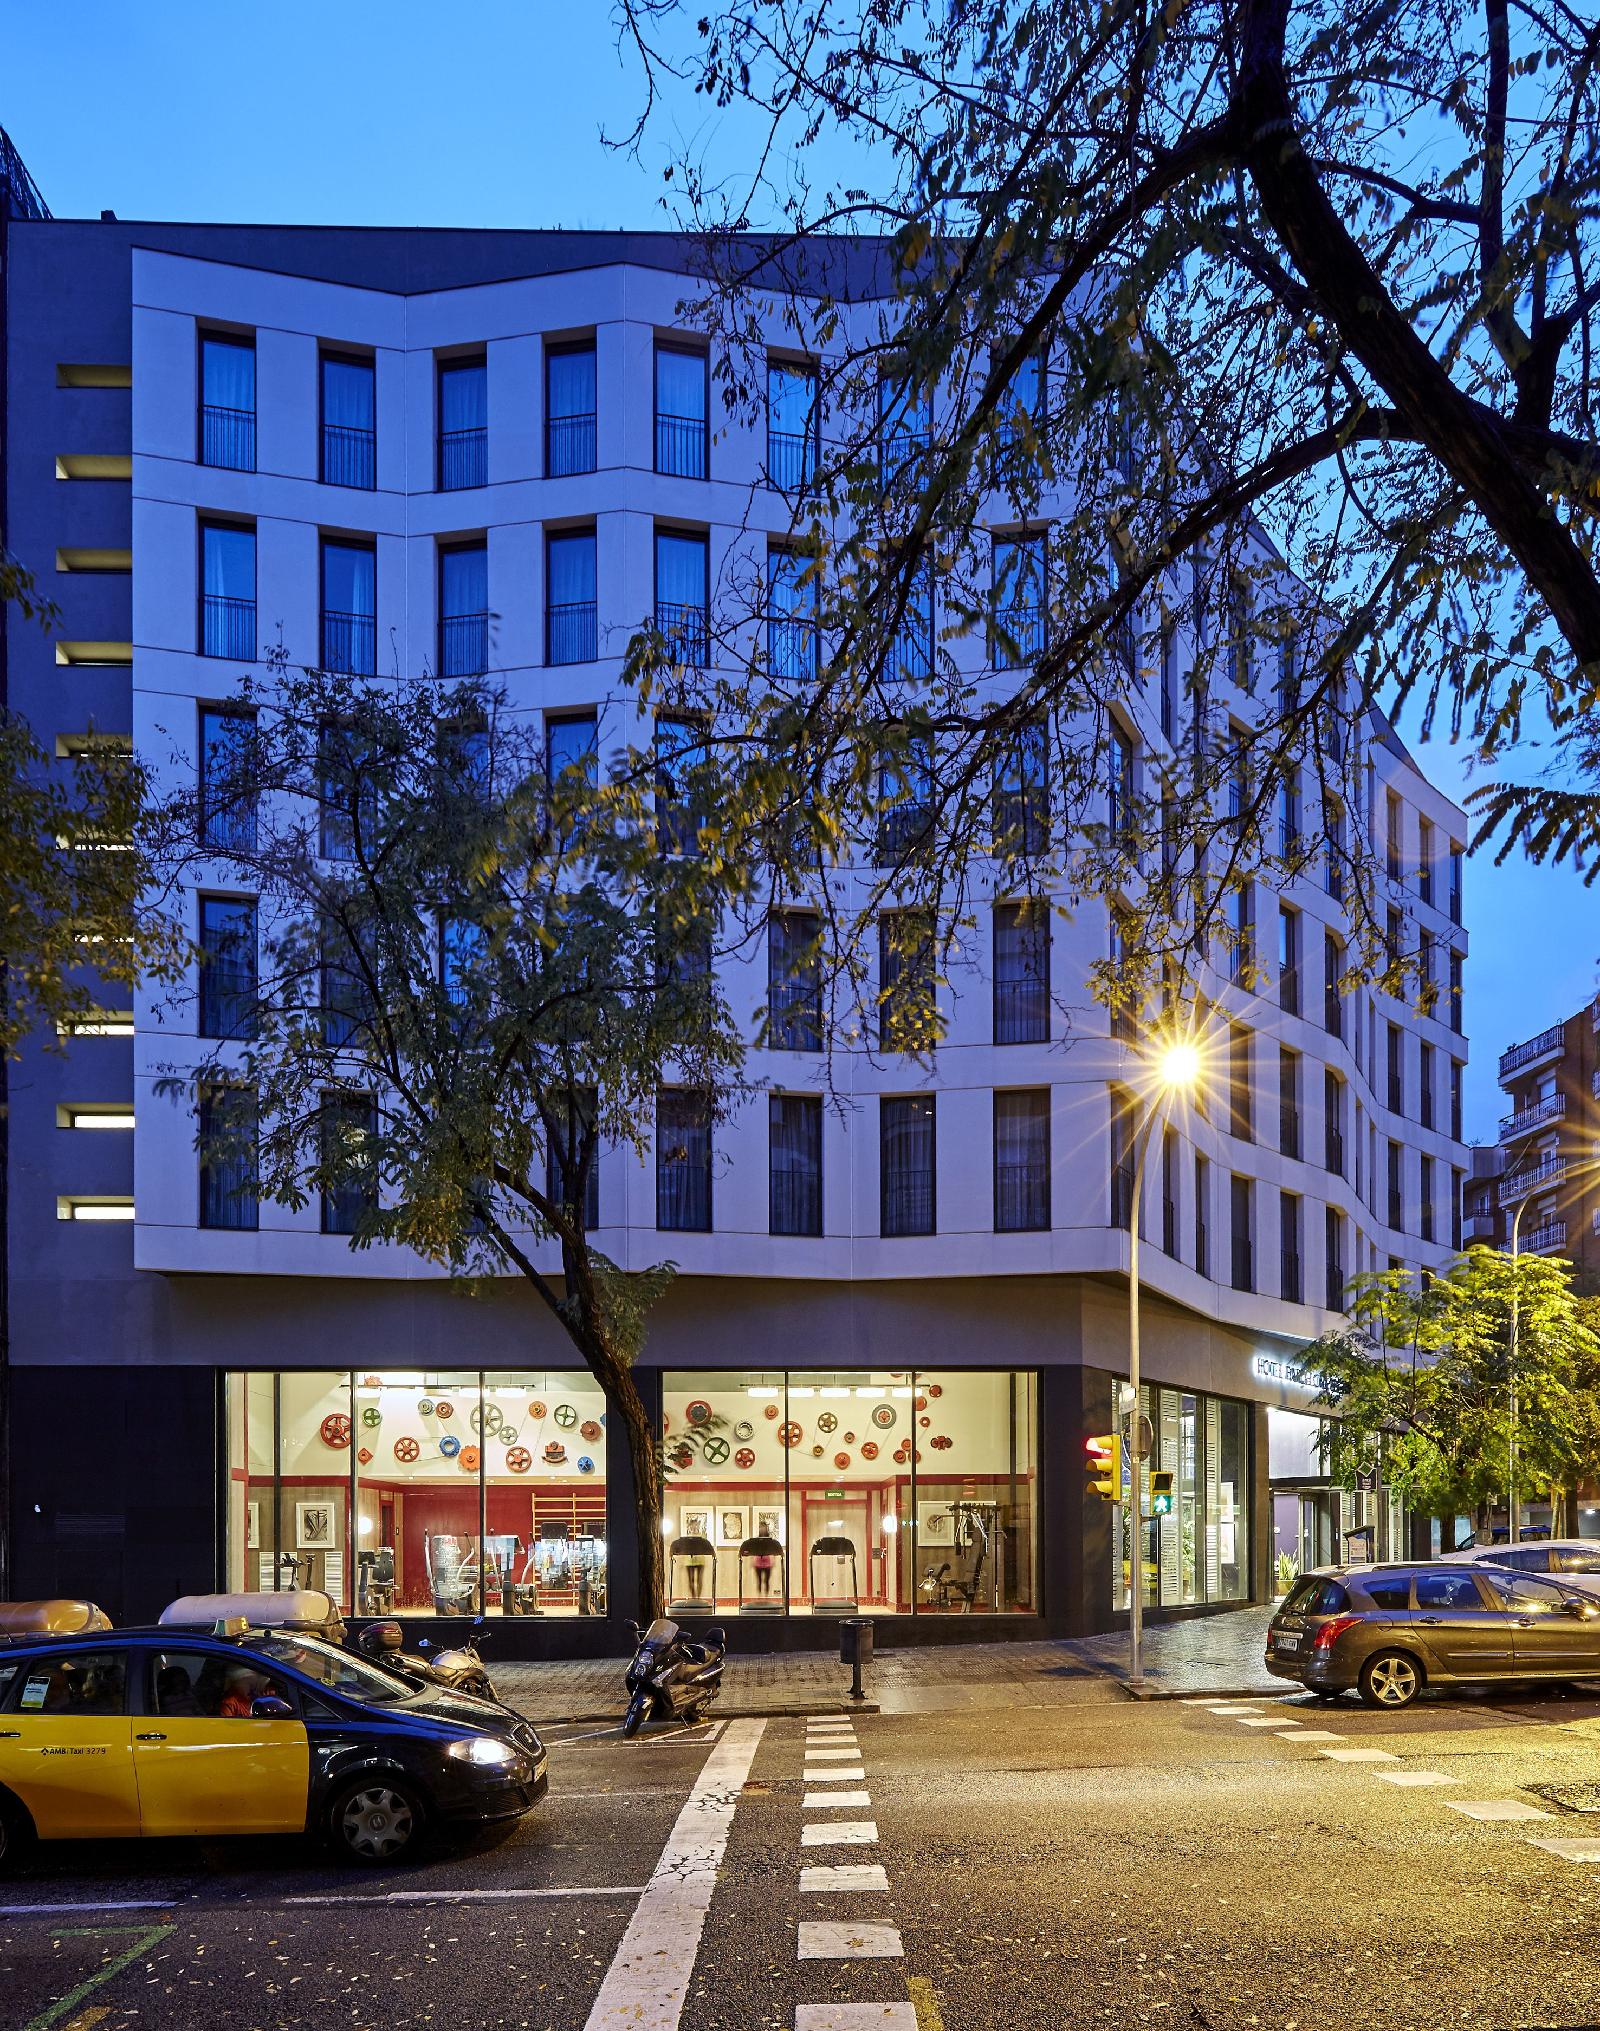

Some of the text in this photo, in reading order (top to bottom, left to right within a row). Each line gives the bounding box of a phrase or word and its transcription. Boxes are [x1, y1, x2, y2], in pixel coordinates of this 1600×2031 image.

[1257, 1358, 1283, 1379] HOTEL
[70, 1747, 84, 1755] Taxi
[86, 1747, 106, 1755] 3279
